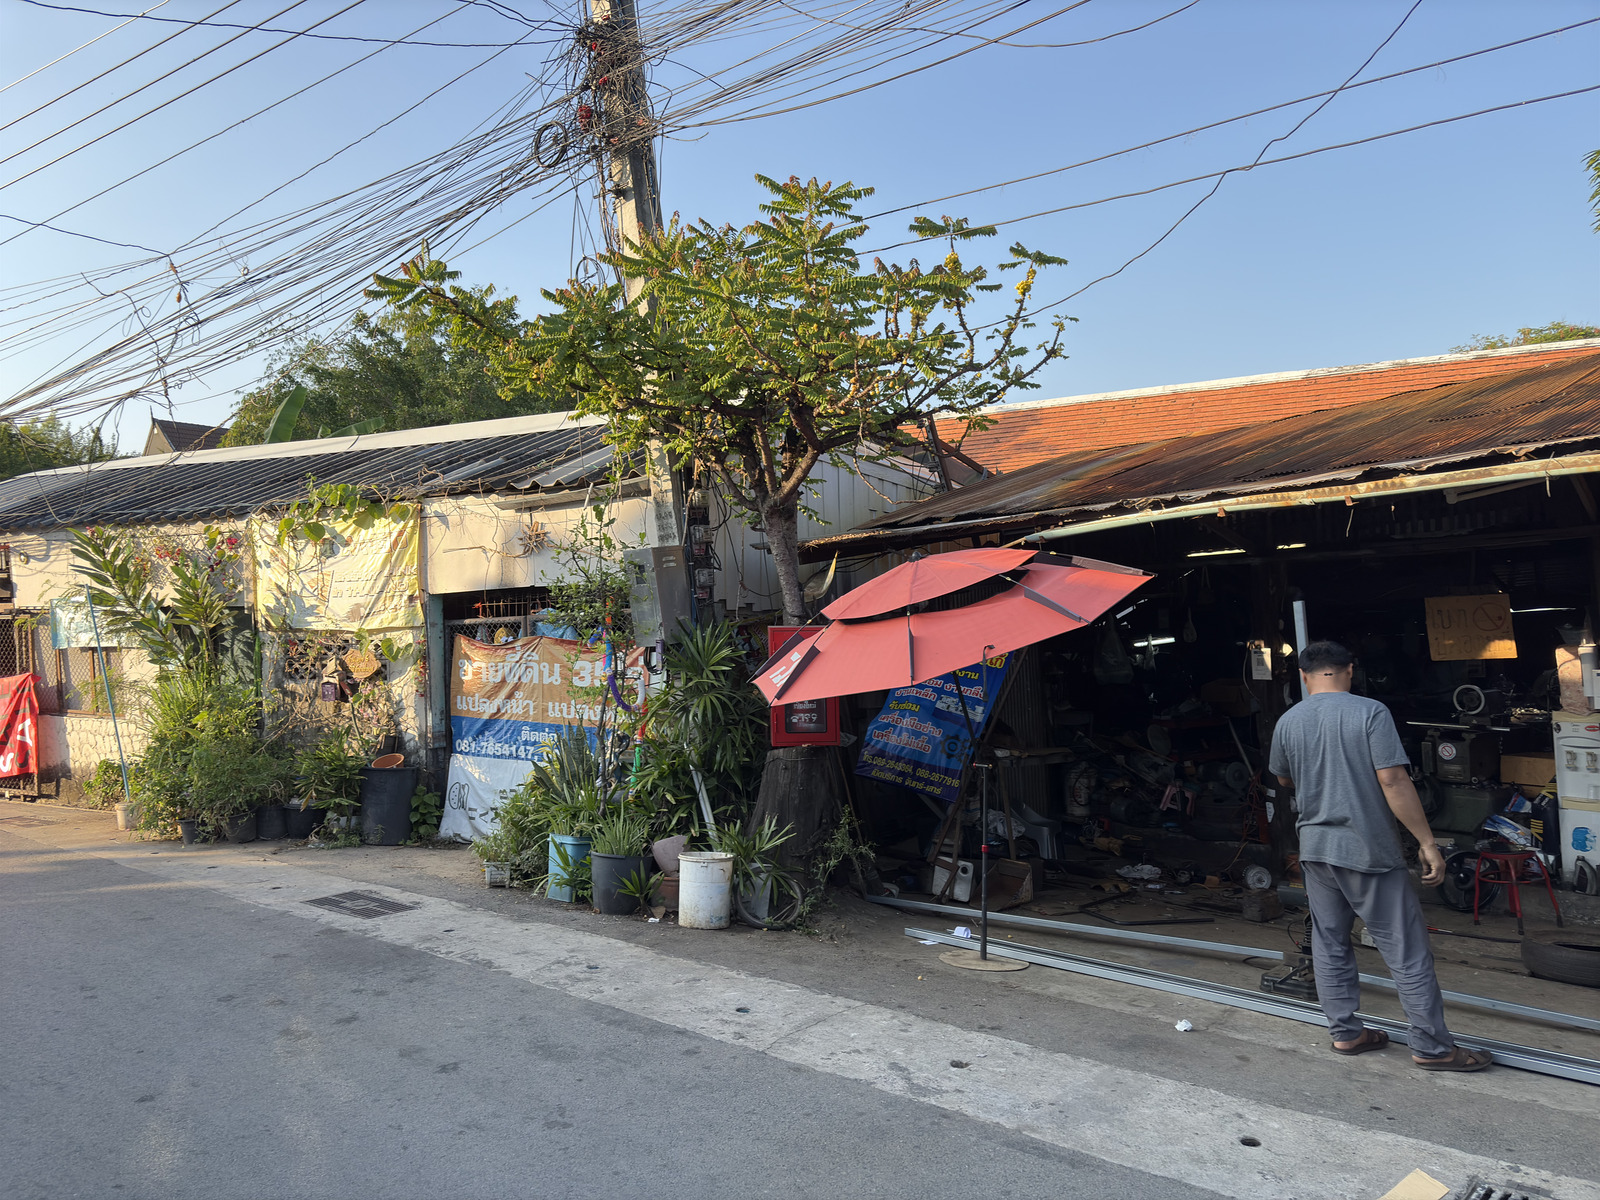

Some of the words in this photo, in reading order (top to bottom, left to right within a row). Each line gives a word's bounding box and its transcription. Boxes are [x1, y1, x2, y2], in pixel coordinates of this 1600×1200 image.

[458, 646, 561, 686] ขายที่ดิน
[456, 691, 534, 716] แปลงหน้า
[895, 687, 937, 701] งานเหล็ก
[889, 700, 920, 712] รับซ่อม
